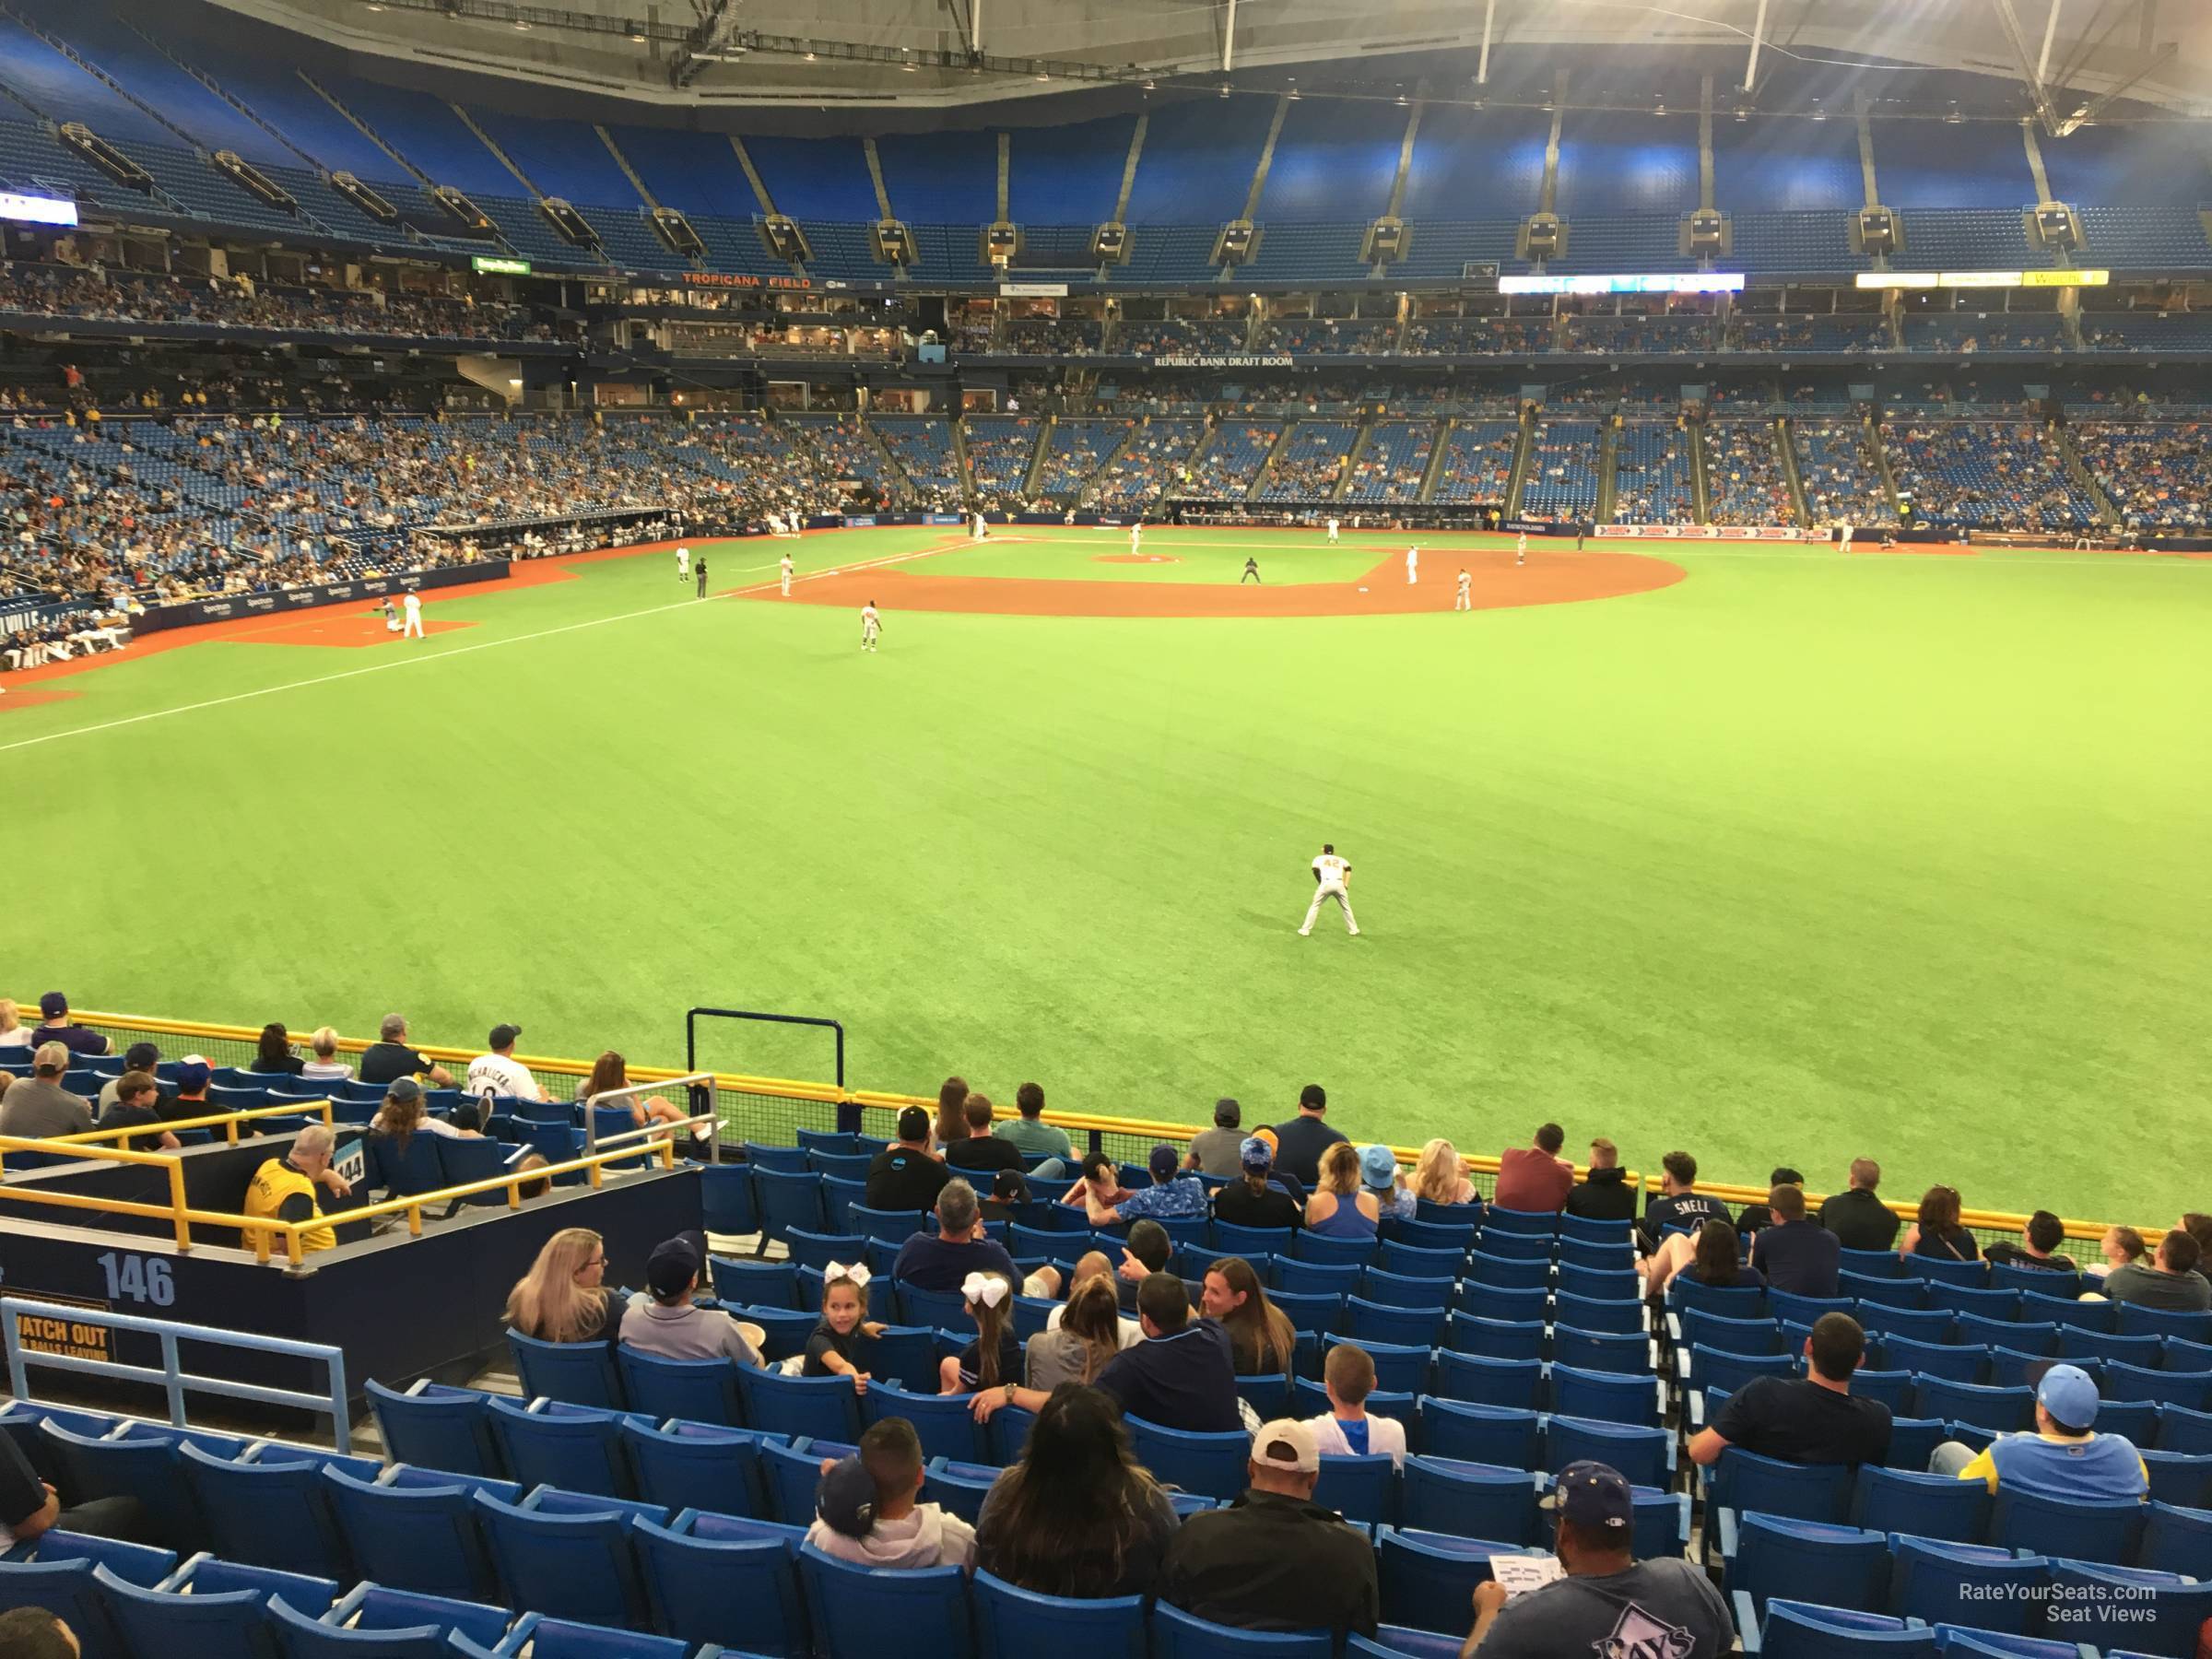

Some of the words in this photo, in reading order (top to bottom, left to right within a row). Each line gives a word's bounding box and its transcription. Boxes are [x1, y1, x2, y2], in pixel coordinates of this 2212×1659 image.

[683, 273, 760, 287] TROPICANA
[769, 277, 811, 288] FIELD
[1154, 357, 1198, 367] REPUBLIC
[1200, 357, 1227, 367] BANK
[1229, 357, 1259, 367] DRAFT
[1262, 357, 1293, 367] ROOM
[1674, 1199, 1711, 1216] SNELL
[97, 1252, 175, 1306] 146
[72, 1324, 108, 1347] OUT
[30, 1339, 63, 1354] BALLS
[65, 1344, 109, 1362] LEAVING
